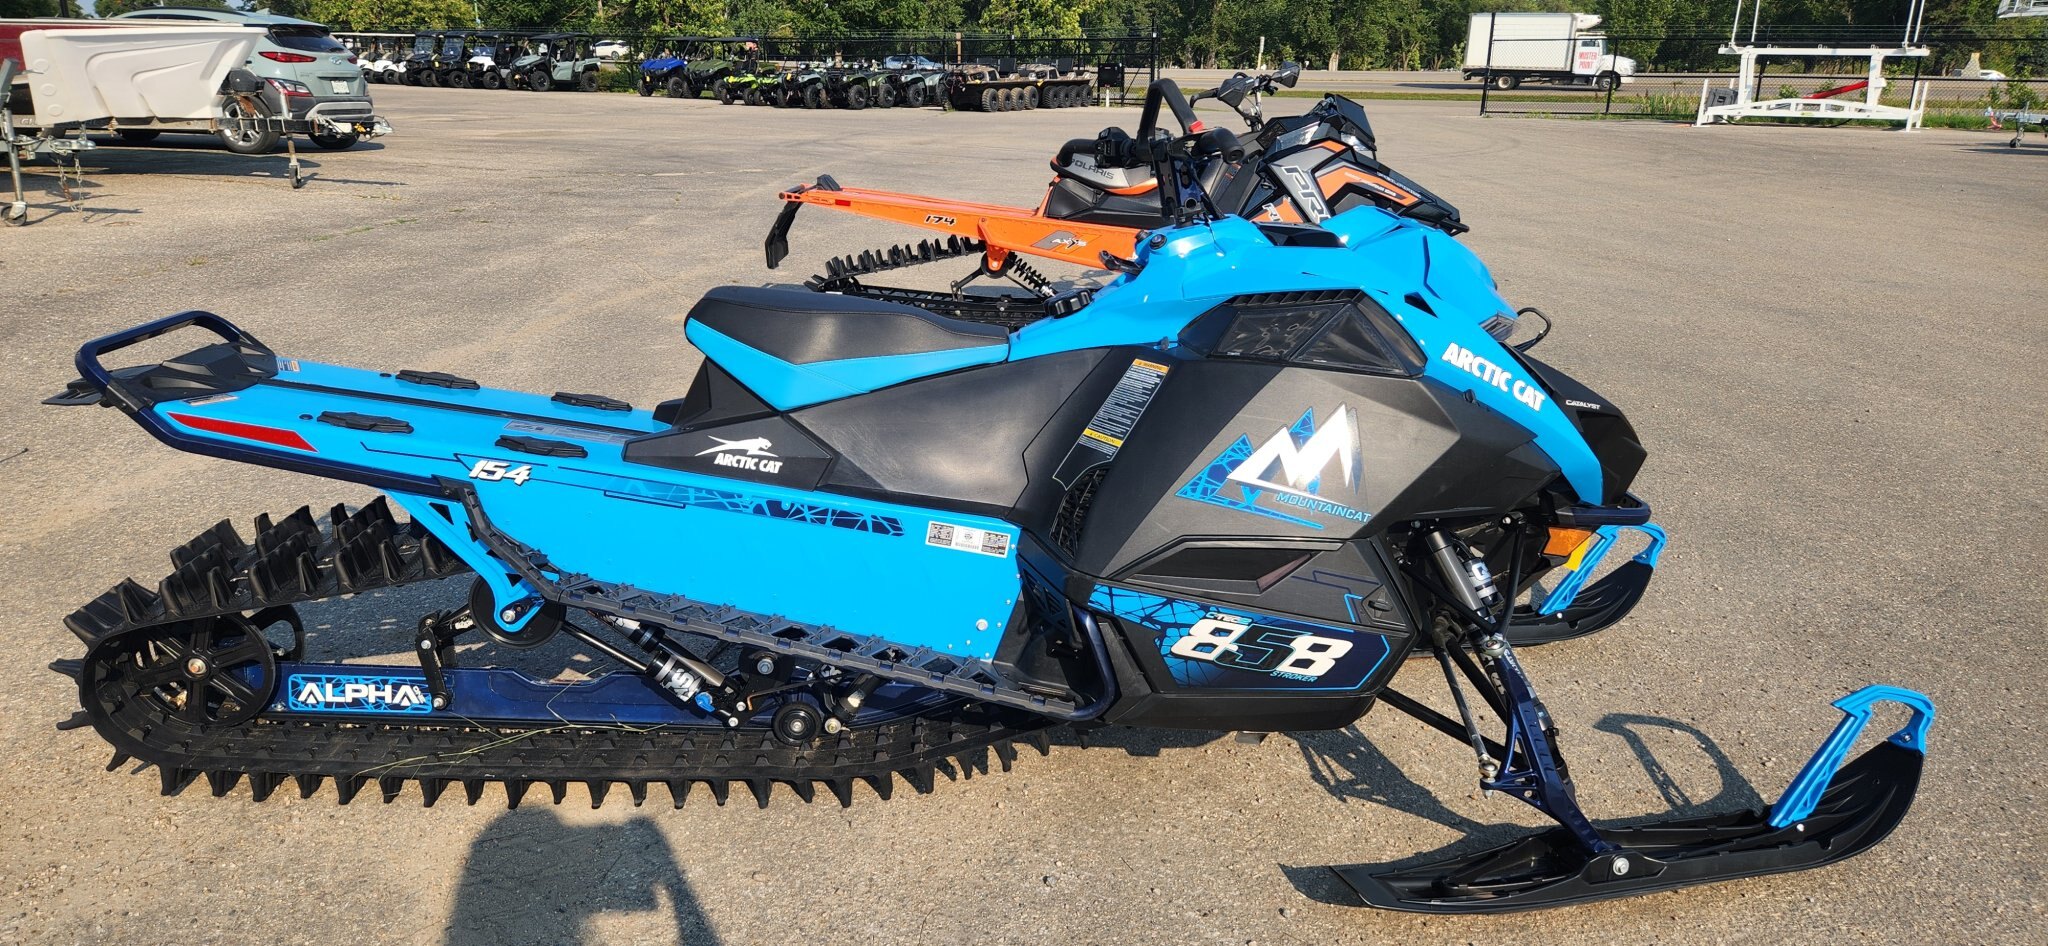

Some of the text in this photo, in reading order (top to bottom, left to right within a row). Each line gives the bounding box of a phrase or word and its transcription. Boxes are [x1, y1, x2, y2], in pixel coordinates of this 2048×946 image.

[1281, 165, 1331, 224] PR
[925, 214, 956, 226] 174
[1442, 342, 1546, 412] ARCTIC CAT
[1565, 399, 1601, 410] CATALYST
[468, 459, 533, 487] 154
[713, 452, 783, 474] ARCTIC CAT
[1276, 491, 1372, 523] MOUNTAINCAT
[1170, 618, 1354, 677] 858
[1270, 670, 1318, 683] STROKER
[298, 682, 420, 707] ALPHA
